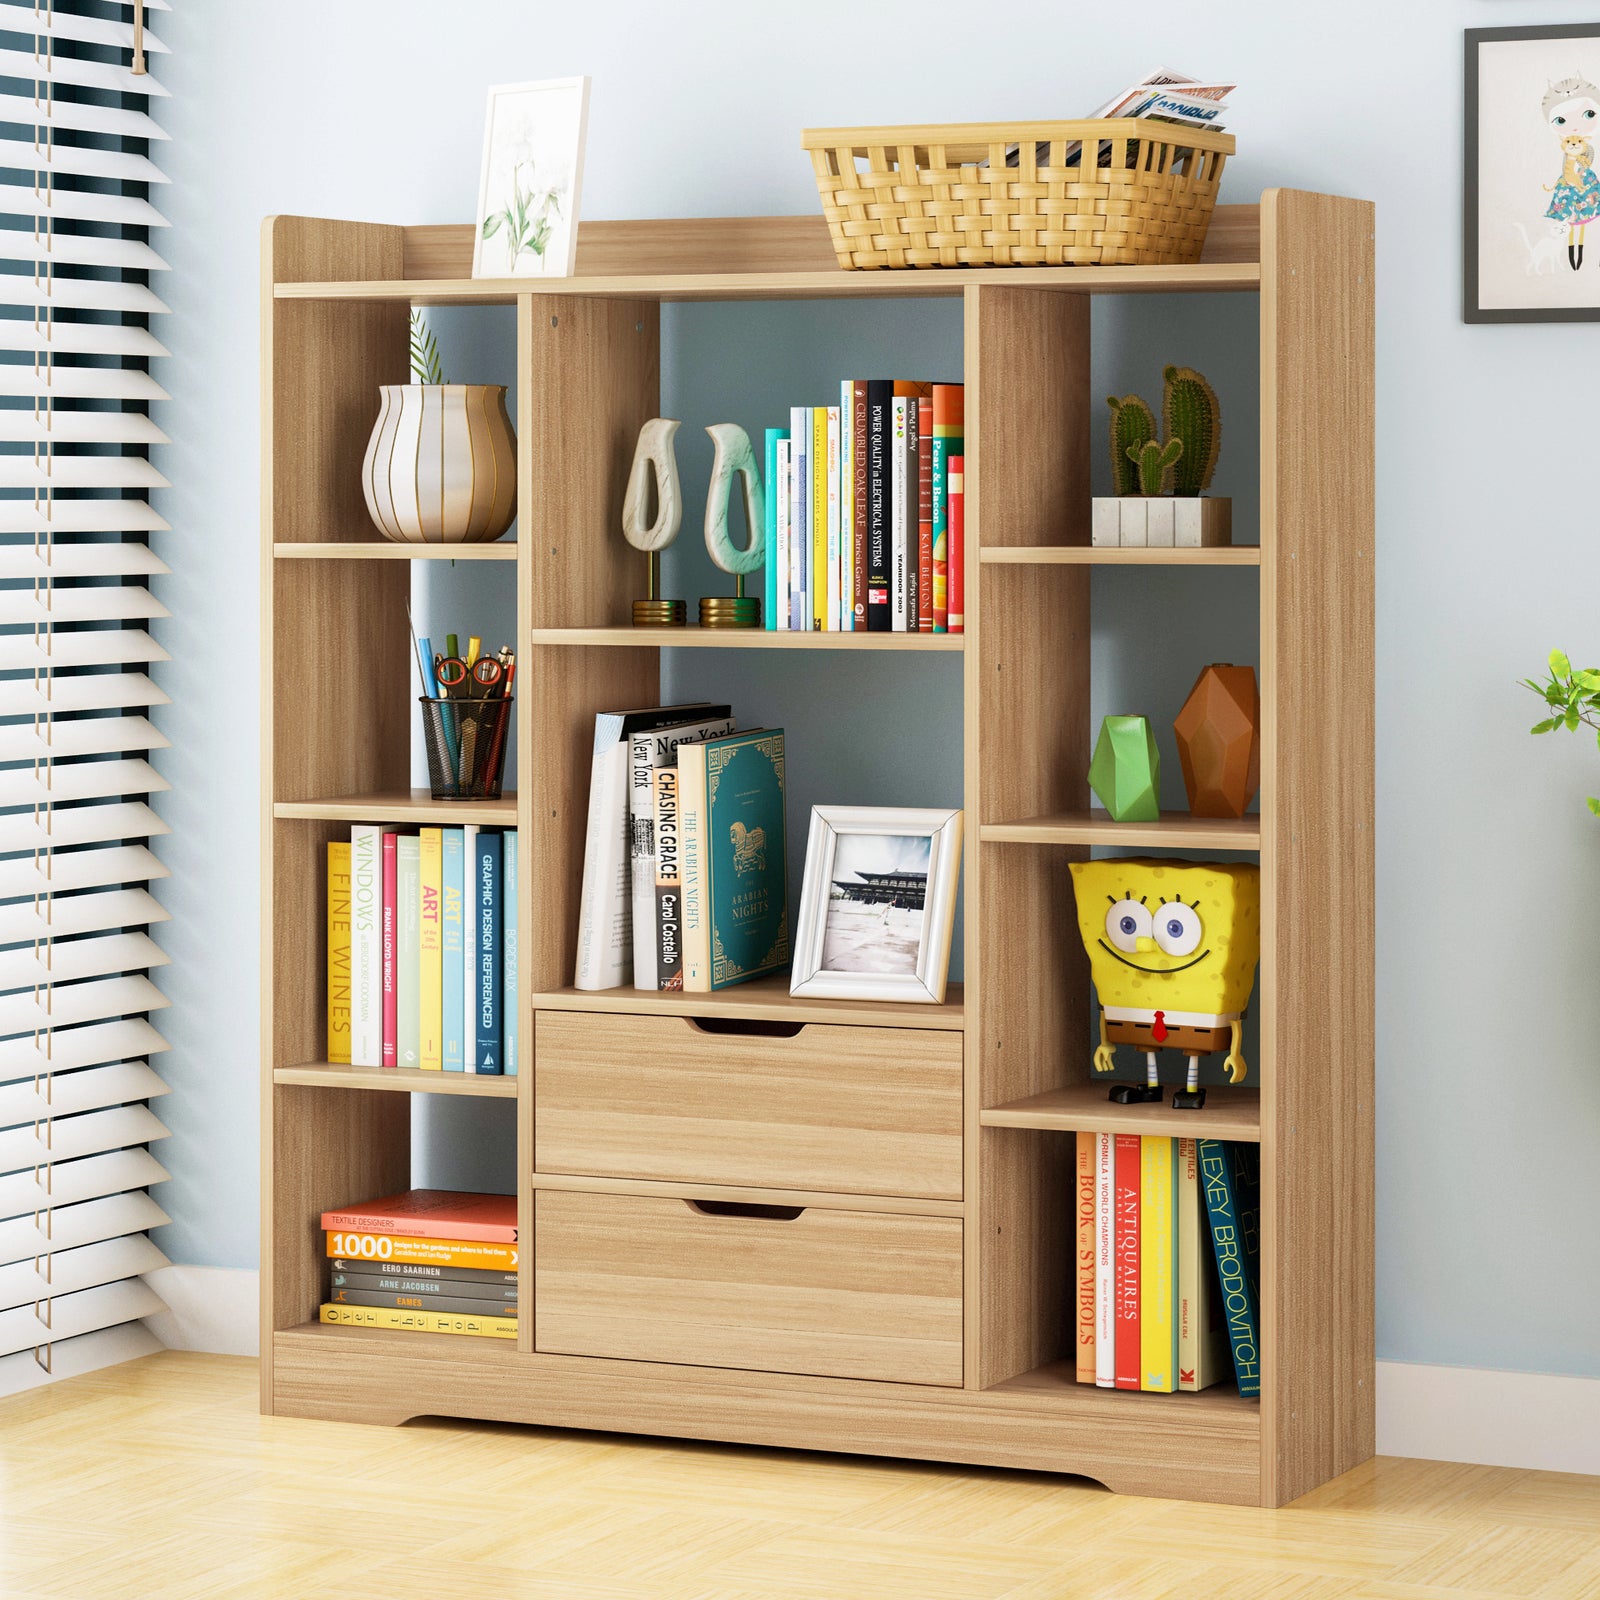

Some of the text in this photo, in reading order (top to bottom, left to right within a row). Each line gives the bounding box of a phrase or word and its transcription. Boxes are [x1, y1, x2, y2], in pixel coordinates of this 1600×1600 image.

[872, 405, 882, 432] POWER
[856, 402, 865, 527] CRUMBLED OAK LEAF
[872, 434, 882, 470] QUALITY
[872, 479, 882, 528] ELECTRICAL
[933, 440, 942, 524] Pear & Bacon
[855, 534, 863, 596] Patricia Gavros
[872, 530, 882, 567] SYSTEMS
[921, 533, 930, 609] KATE BEATON
[633, 738, 652, 788] New York
[656, 736, 693, 756] New
[658, 773, 677, 879] CHASING GRACE
[357, 834, 374, 932] WINDOWS
[483, 855, 492, 906] GRAPHIC
[684, 811, 698, 929] THE ARABIAN NIGHTS
[333, 874, 350, 932] FINE
[423, 886, 438, 923] ART
[446, 886, 460, 924] ART
[732, 888, 768, 905] ARABIAN
[732, 900, 768, 920] NIGHTS
[483, 909, 492, 950] DESIGN
[662, 894, 678, 964] Carol Costello
[506, 929, 516, 992] BORDEAUX
[333, 946, 350, 1033] WINES
[360, 982, 369, 1022] GOODMAN
[483, 954, 492, 1028] REFERENCED
[1188, 1139, 1196, 1180] TEXTILES
[332, 1216, 394, 1228] TEXTILE DESIGNERS
[1080, 1174, 1094, 1228] BOOK
[332, 1234, 392, 1258] 1000
[1080, 1233, 1087, 1247] OF
[1122, 1188, 1136, 1320] ANTIQUAIRES
[380, 1280, 440, 1292] ARNE JACOBSEN
[382, 1264, 440, 1276] EERO SAARINEN
[396, 1297, 422, 1307] EAMES
[1080, 1250, 1094, 1346] SYMBOLS
[1214, 1225, 1260, 1380] BRODOVITCH
[438, 1320, 480, 1332] Top
